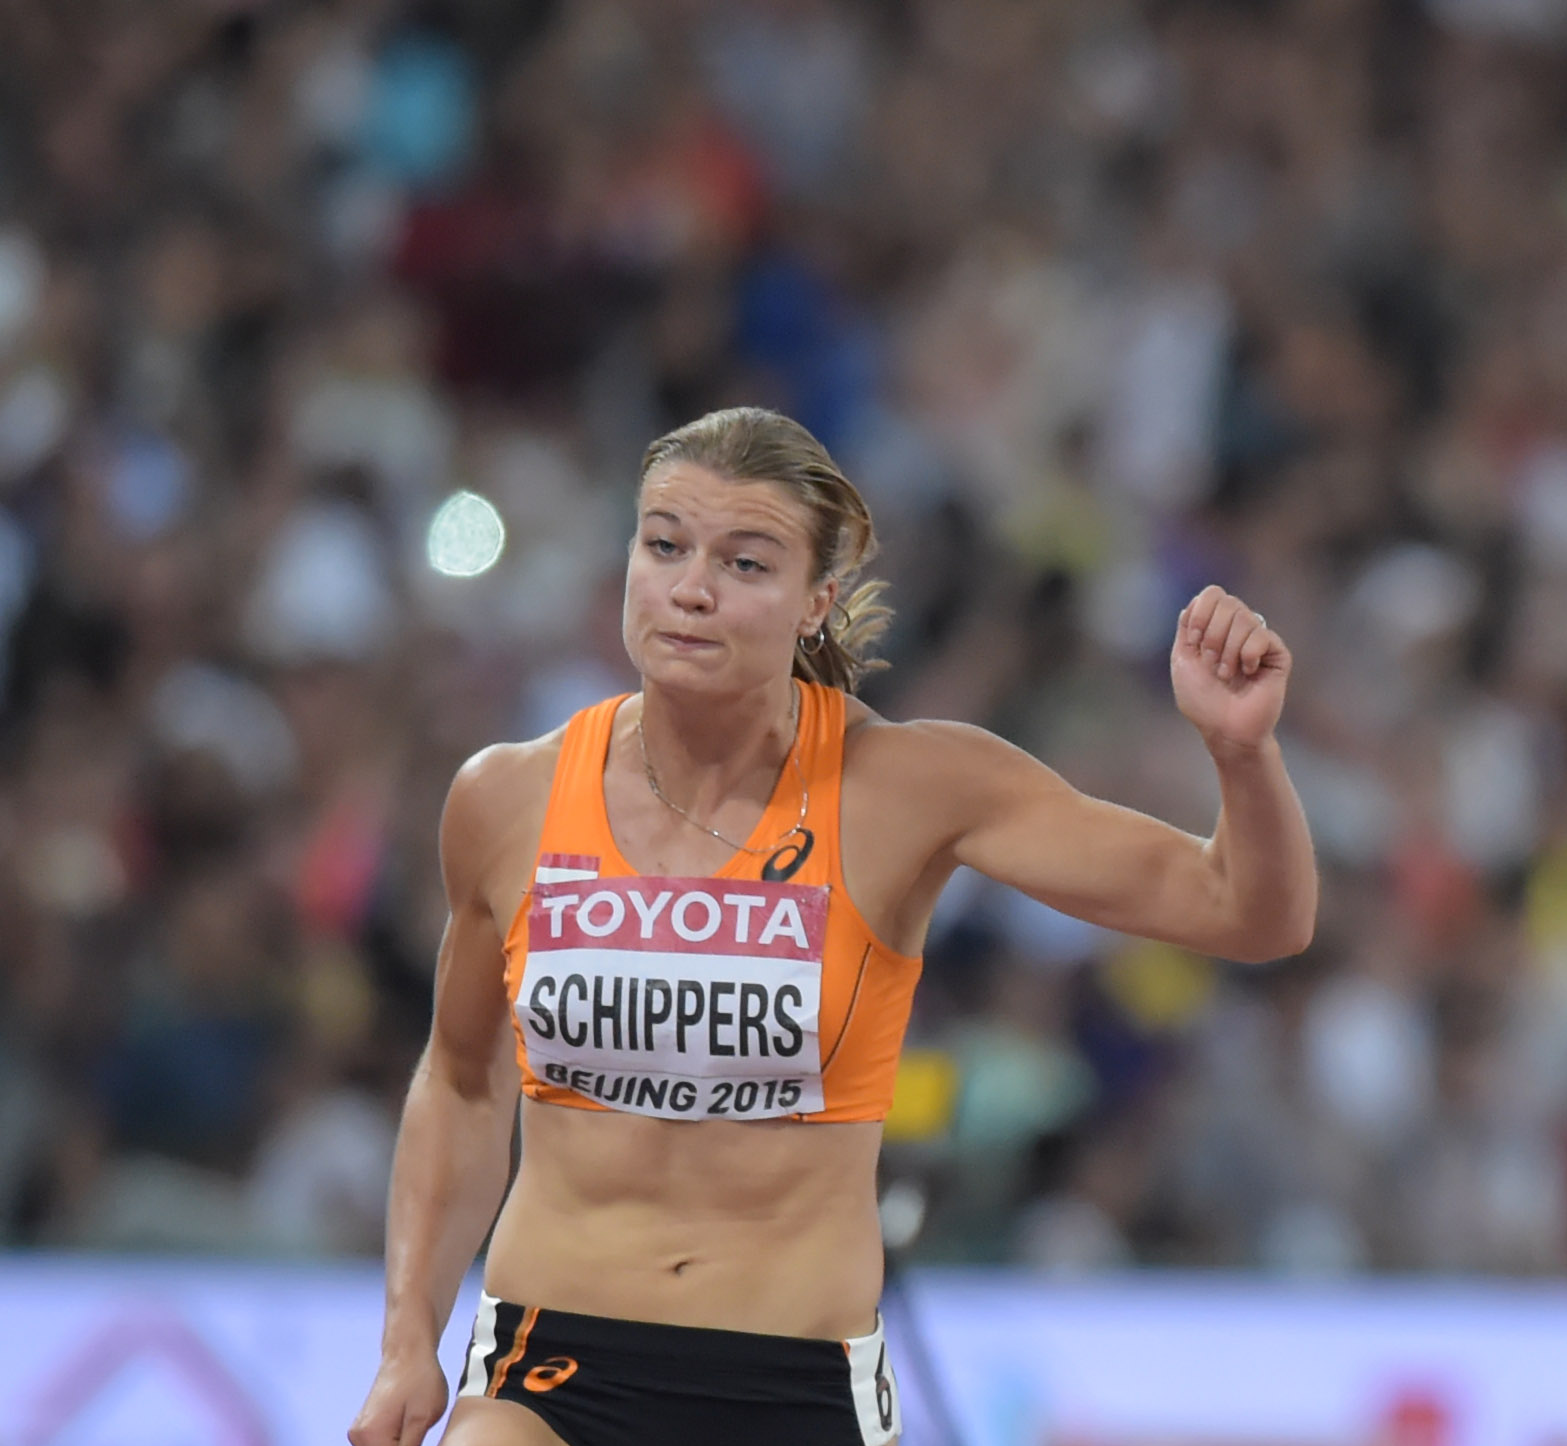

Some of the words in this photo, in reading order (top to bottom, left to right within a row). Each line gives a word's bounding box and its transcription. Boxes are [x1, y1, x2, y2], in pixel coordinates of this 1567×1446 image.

[542, 891, 809, 949] TOYOTA
[529, 973, 803, 1057] SCHIPPERS
[545, 1063, 697, 1111] BEIJING
[707, 1079, 803, 1114] 2015
[874, 1341, 892, 1431] 6
